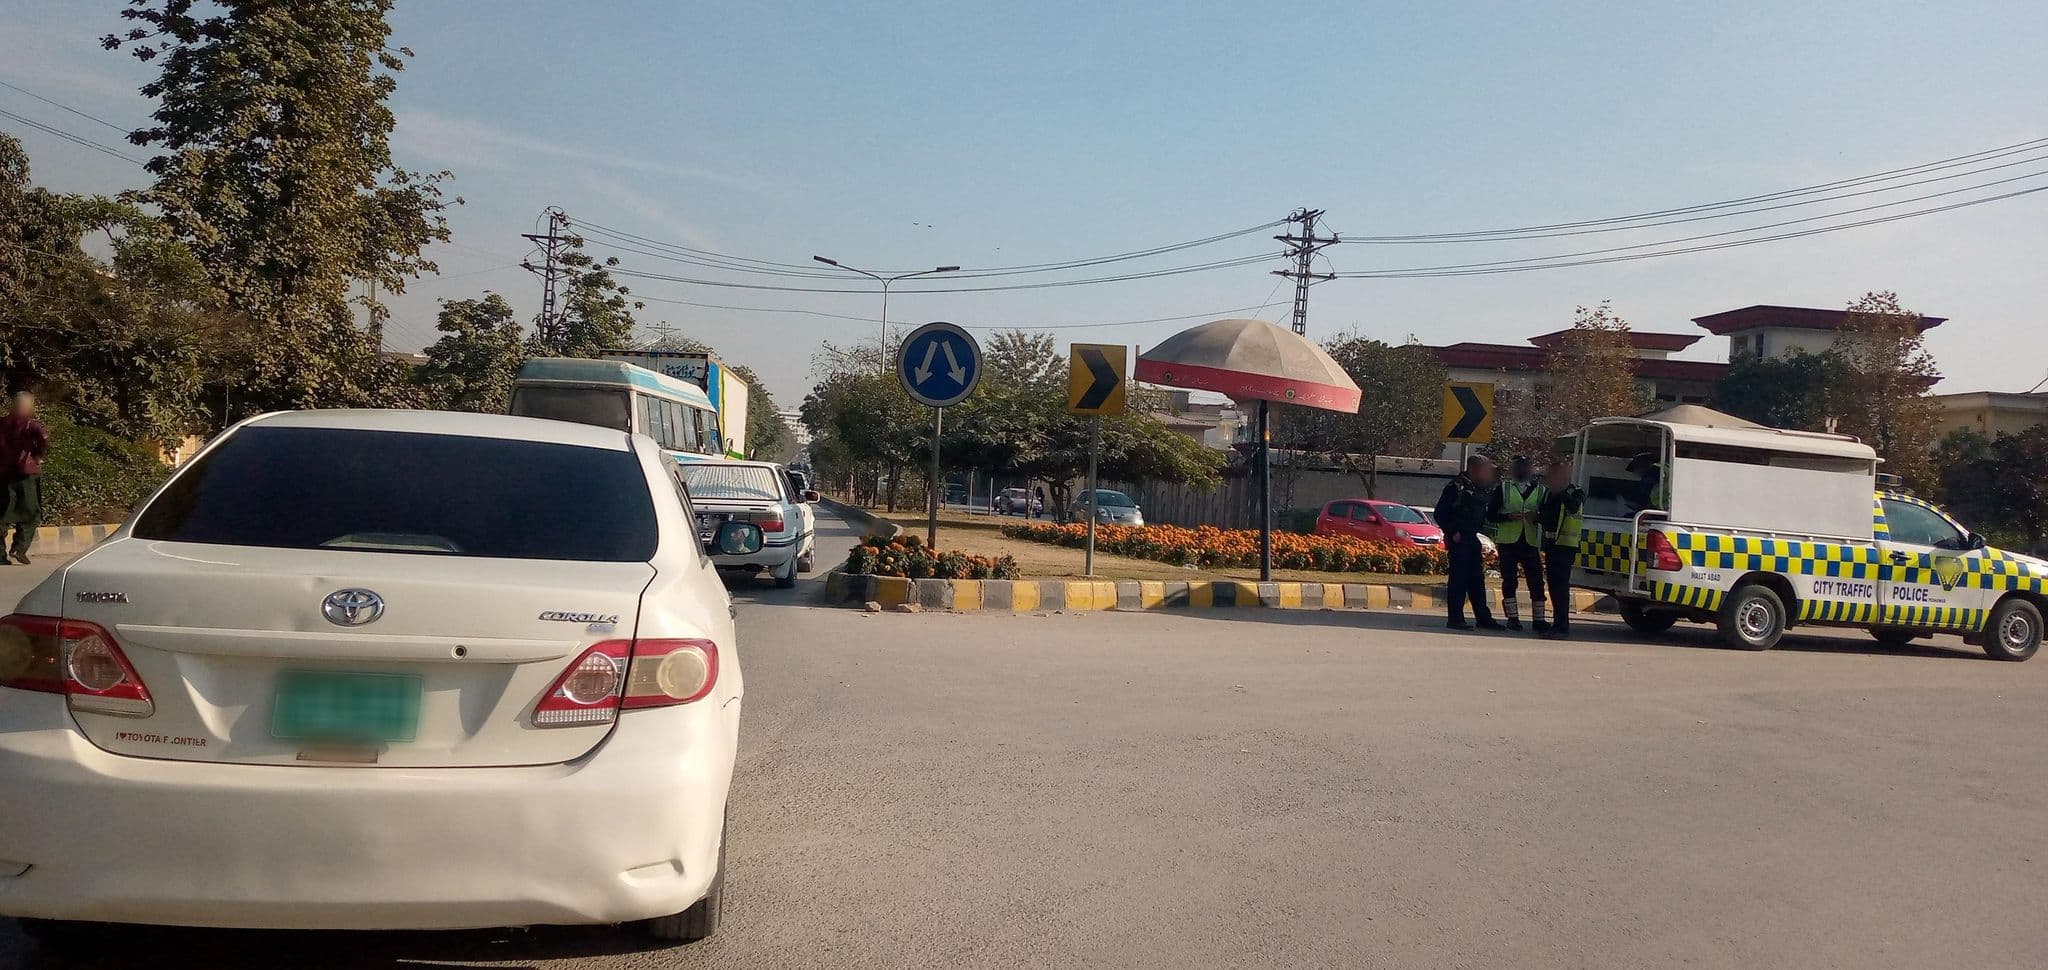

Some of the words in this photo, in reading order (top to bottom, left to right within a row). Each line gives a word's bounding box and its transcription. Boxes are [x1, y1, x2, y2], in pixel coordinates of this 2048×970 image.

[1813, 580, 1834, 595] CITY
[1836, 582, 1873, 598] TRAFFIC
[1892, 586, 1929, 602] POLICE
[538, 611, 618, 624] COROLLA
[162, 735, 206, 747] FONTIER
